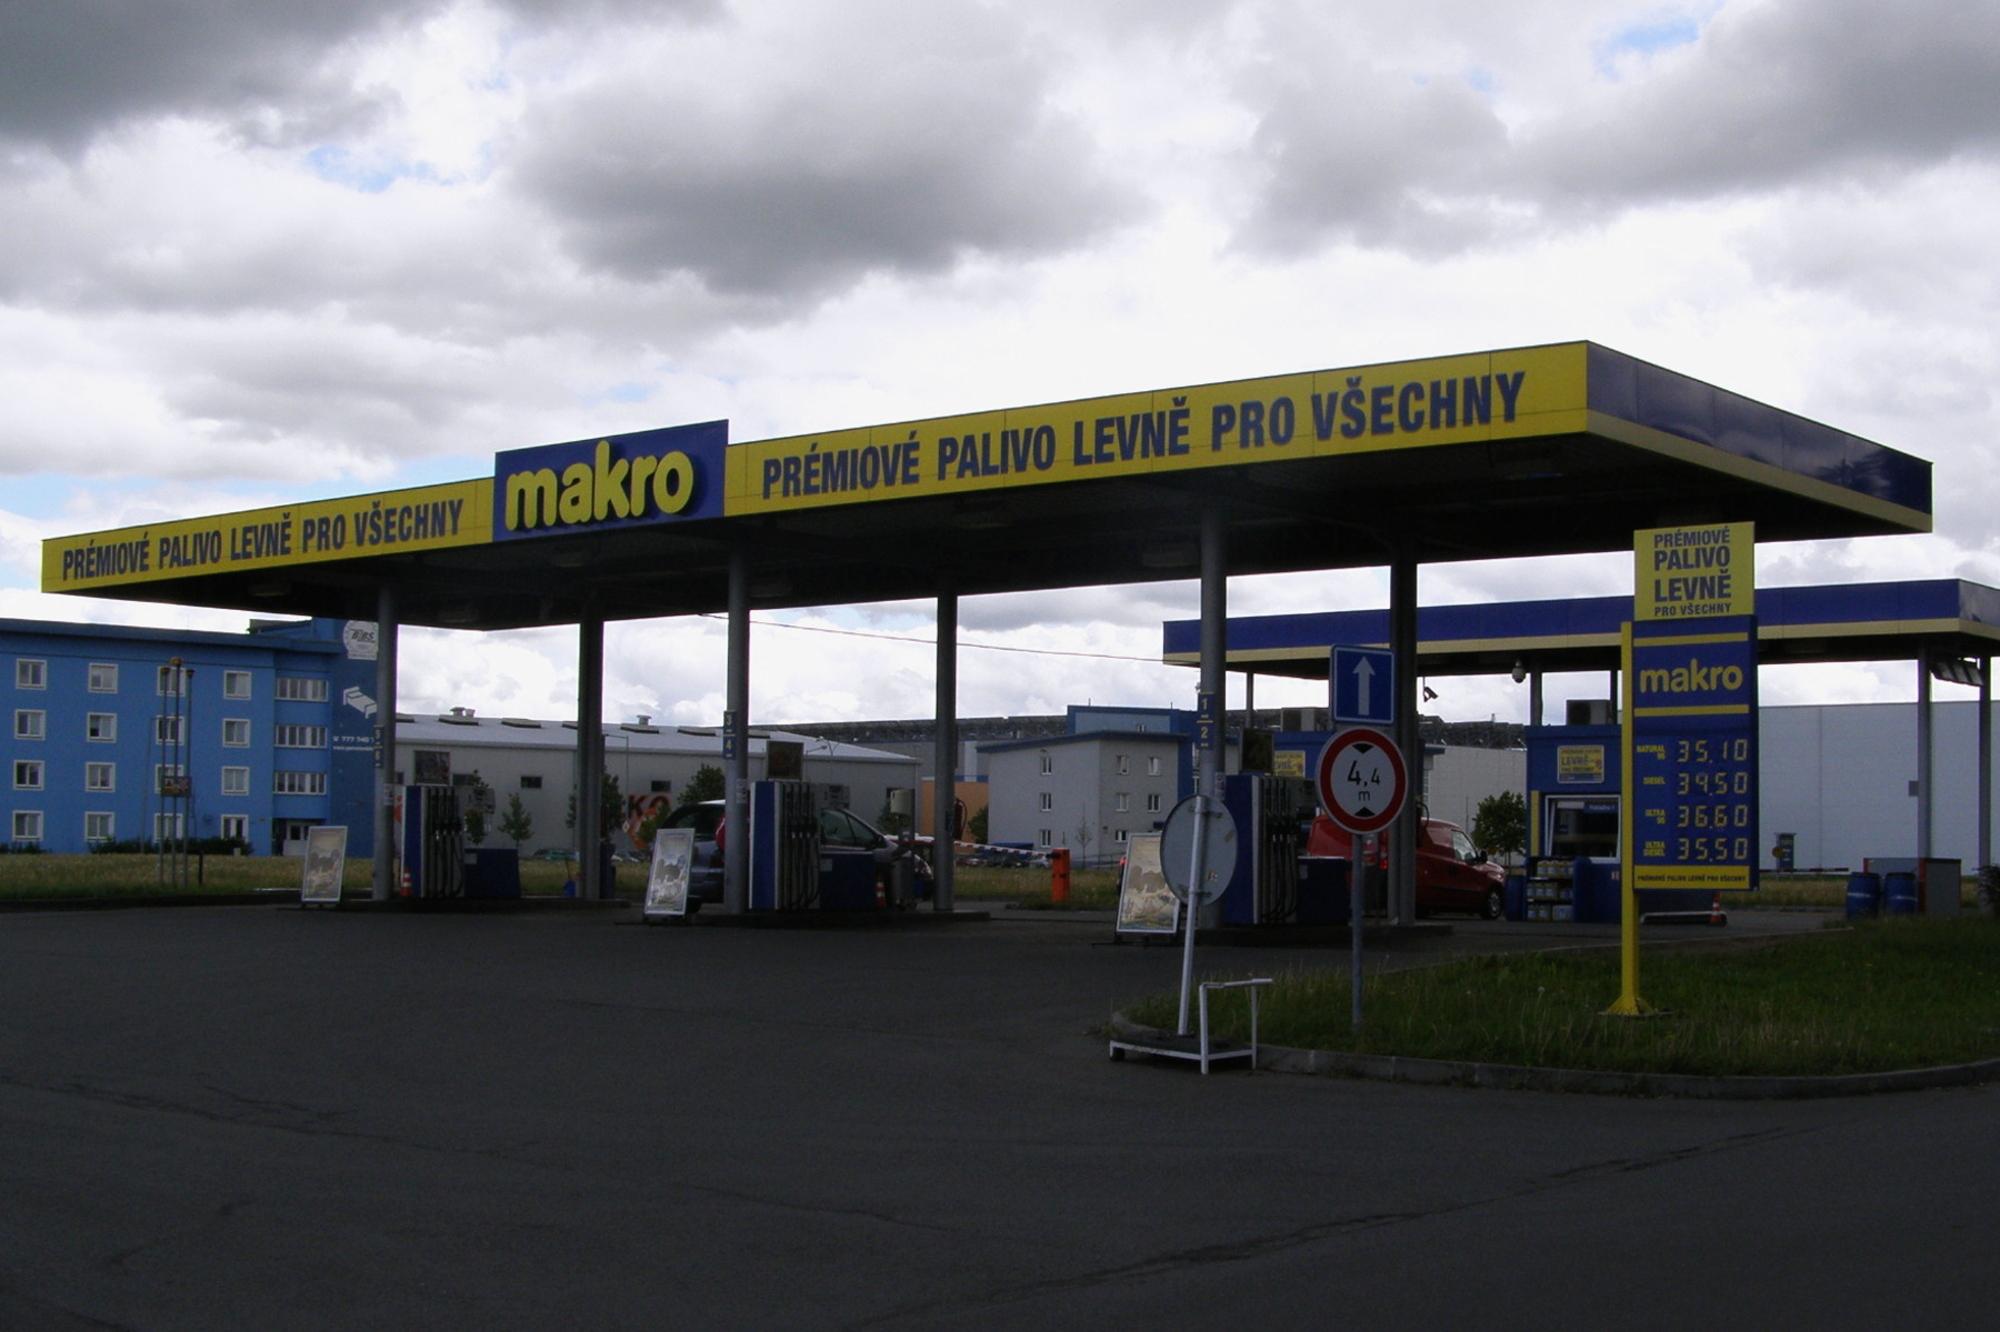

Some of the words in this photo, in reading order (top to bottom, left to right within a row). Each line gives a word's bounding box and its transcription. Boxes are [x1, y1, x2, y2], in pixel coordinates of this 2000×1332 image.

[763, 430, 920, 499] PRÉMIOVÉ
[937, 425, 1055, 481] PALIVO
[1073, 396, 1190, 467] LEVNĚ
[1211, 396, 1295, 451] PRO
[1311, 371, 1525, 441] VŠECHNY
[505, 439, 694, 531] makro
[62, 532, 150, 581] PRÉMIOVÉ
[159, 529, 222, 569] PALIVO
[230, 512, 292, 560] LEVNĚ
[303, 513, 346, 552] PRO
[354, 499, 464, 546] VŠECHNY
[1654, 525, 1730, 548] PRÉMIOVÉ
[1654, 545, 1731, 571] PALIVO
[1654, 568, 1731, 603] LEVNĚ
[1654, 605, 1676, 616] PRO
[1680, 602, 1732, 615] VŠECHNY
[1639, 657, 1743, 693] makro
[1677, 738, 1748, 763] 35.10
[1358, 790, 1371, 801] m
[1677, 804, 1748, 829] 36.60
[1677, 837, 1748, 862] 35.50
